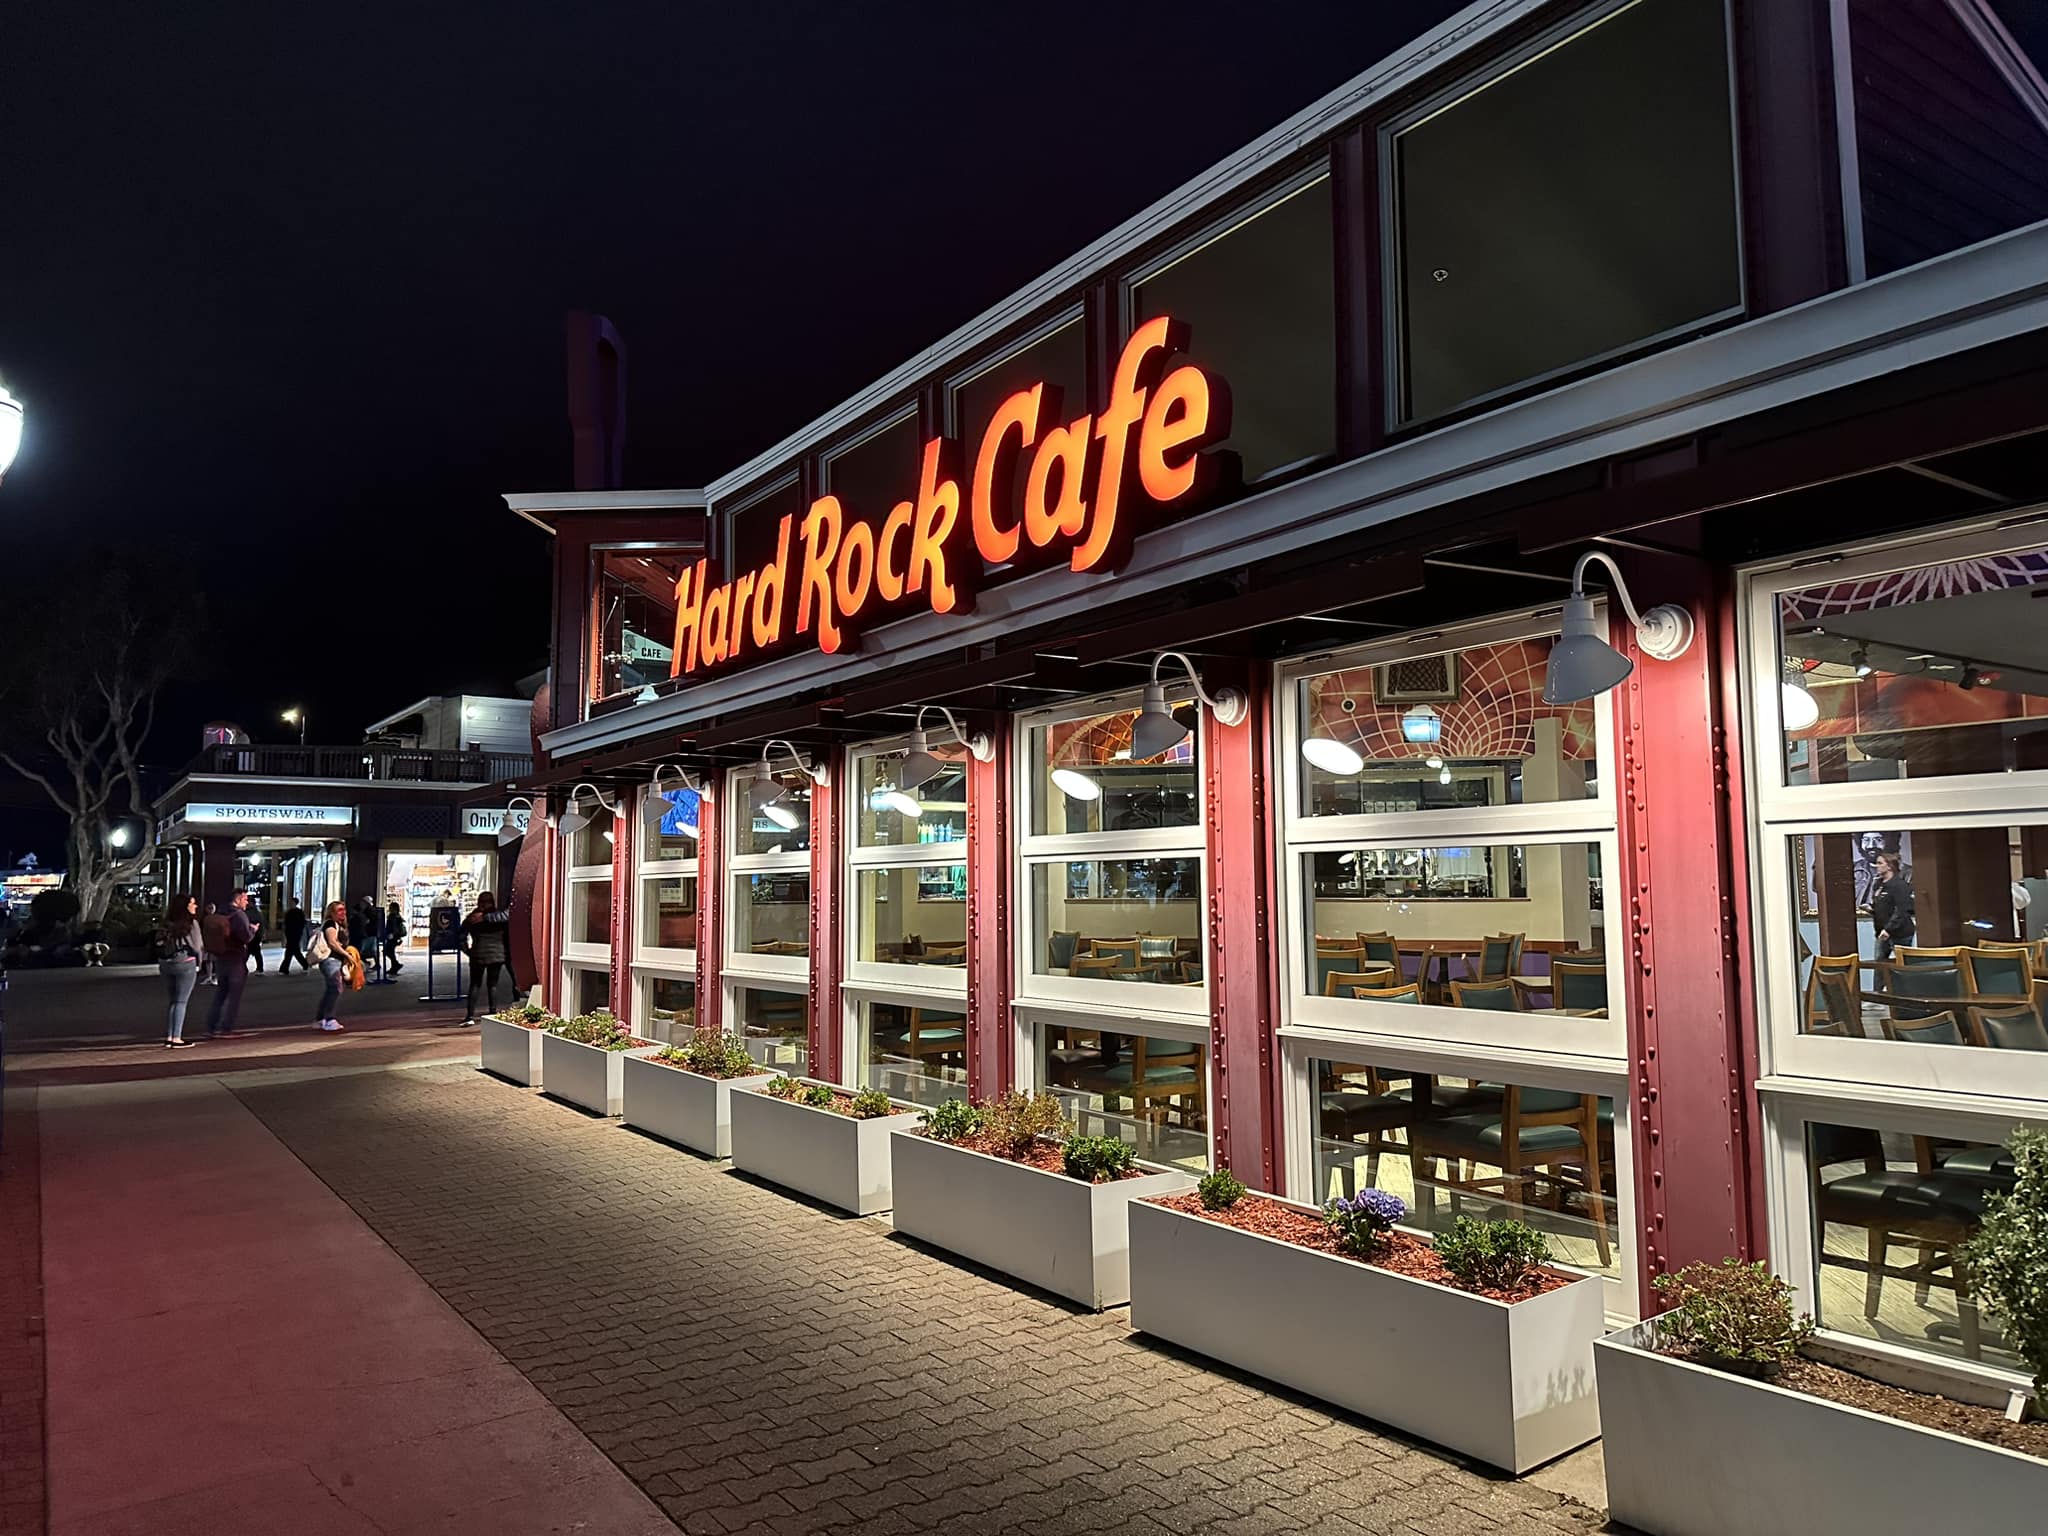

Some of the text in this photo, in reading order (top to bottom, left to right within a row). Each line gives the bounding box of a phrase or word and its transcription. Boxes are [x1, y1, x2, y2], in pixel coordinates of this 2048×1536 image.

[670, 316, 1209, 678] Hard Rock Cafe
[641, 647, 662, 659] CAFE
[215, 807, 326, 820] SPORTSWEAR
[470, 812, 499, 832] Only
